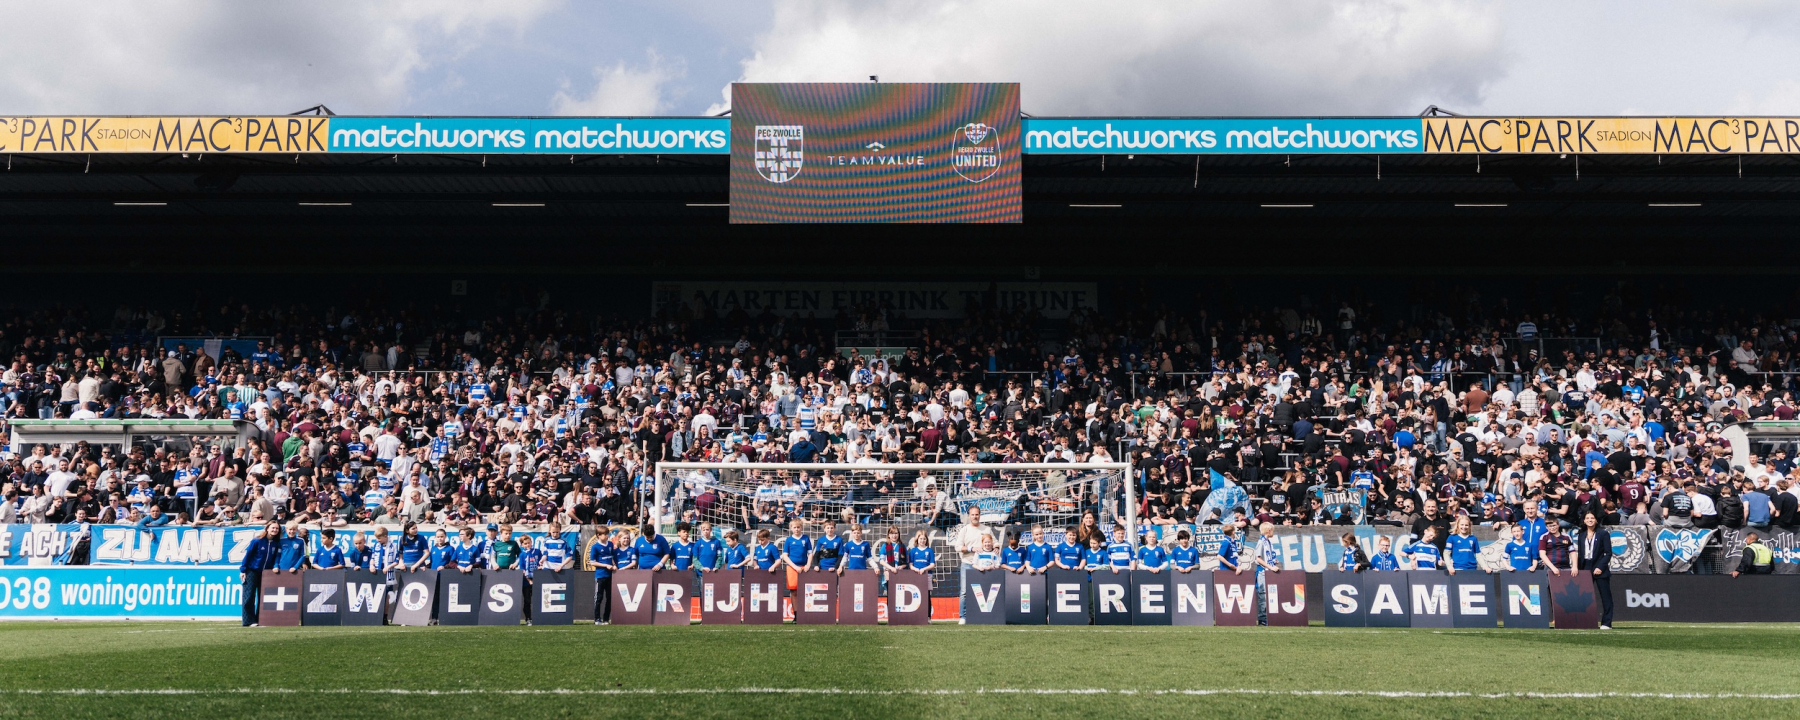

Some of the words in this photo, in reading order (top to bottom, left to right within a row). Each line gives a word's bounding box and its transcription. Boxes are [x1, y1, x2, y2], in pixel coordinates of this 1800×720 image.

[97, 128, 151, 140] STADION
[332, 122, 525, 148] matchworks
[535, 123, 726, 149] matchworks
[757, 128, 771, 138] PEC
[772, 128, 801, 138] ZWOLLE
[1026, 123, 1217, 149] matchworks
[1226, 123, 1418, 149] matchworks
[1596, 130, 1652, 142] STADION
[974, 146, 994, 154] ZWOLLE
[955, 154, 997, 167] UNITED
[697, 290, 821, 310] MARTEN
[959, 290, 1088, 310] TIBUNE
[1323, 492, 1360, 505] ULTRAS
[1630, 488, 1639, 500] 9
[96, 528, 152, 561] ZIJ
[155, 529, 225, 563] AAN
[61, 576, 243, 611] woningontruimin
[306, 581, 567, 613] ZWOLSE
[616, 583, 921, 613] VRIJHEID
[970, 583, 1206, 613] VIEREN
[1215, 583, 1306, 614] WIJ
[1331, 584, 1542, 616] SAMEN
[1625, 589, 1670, 608] bon
